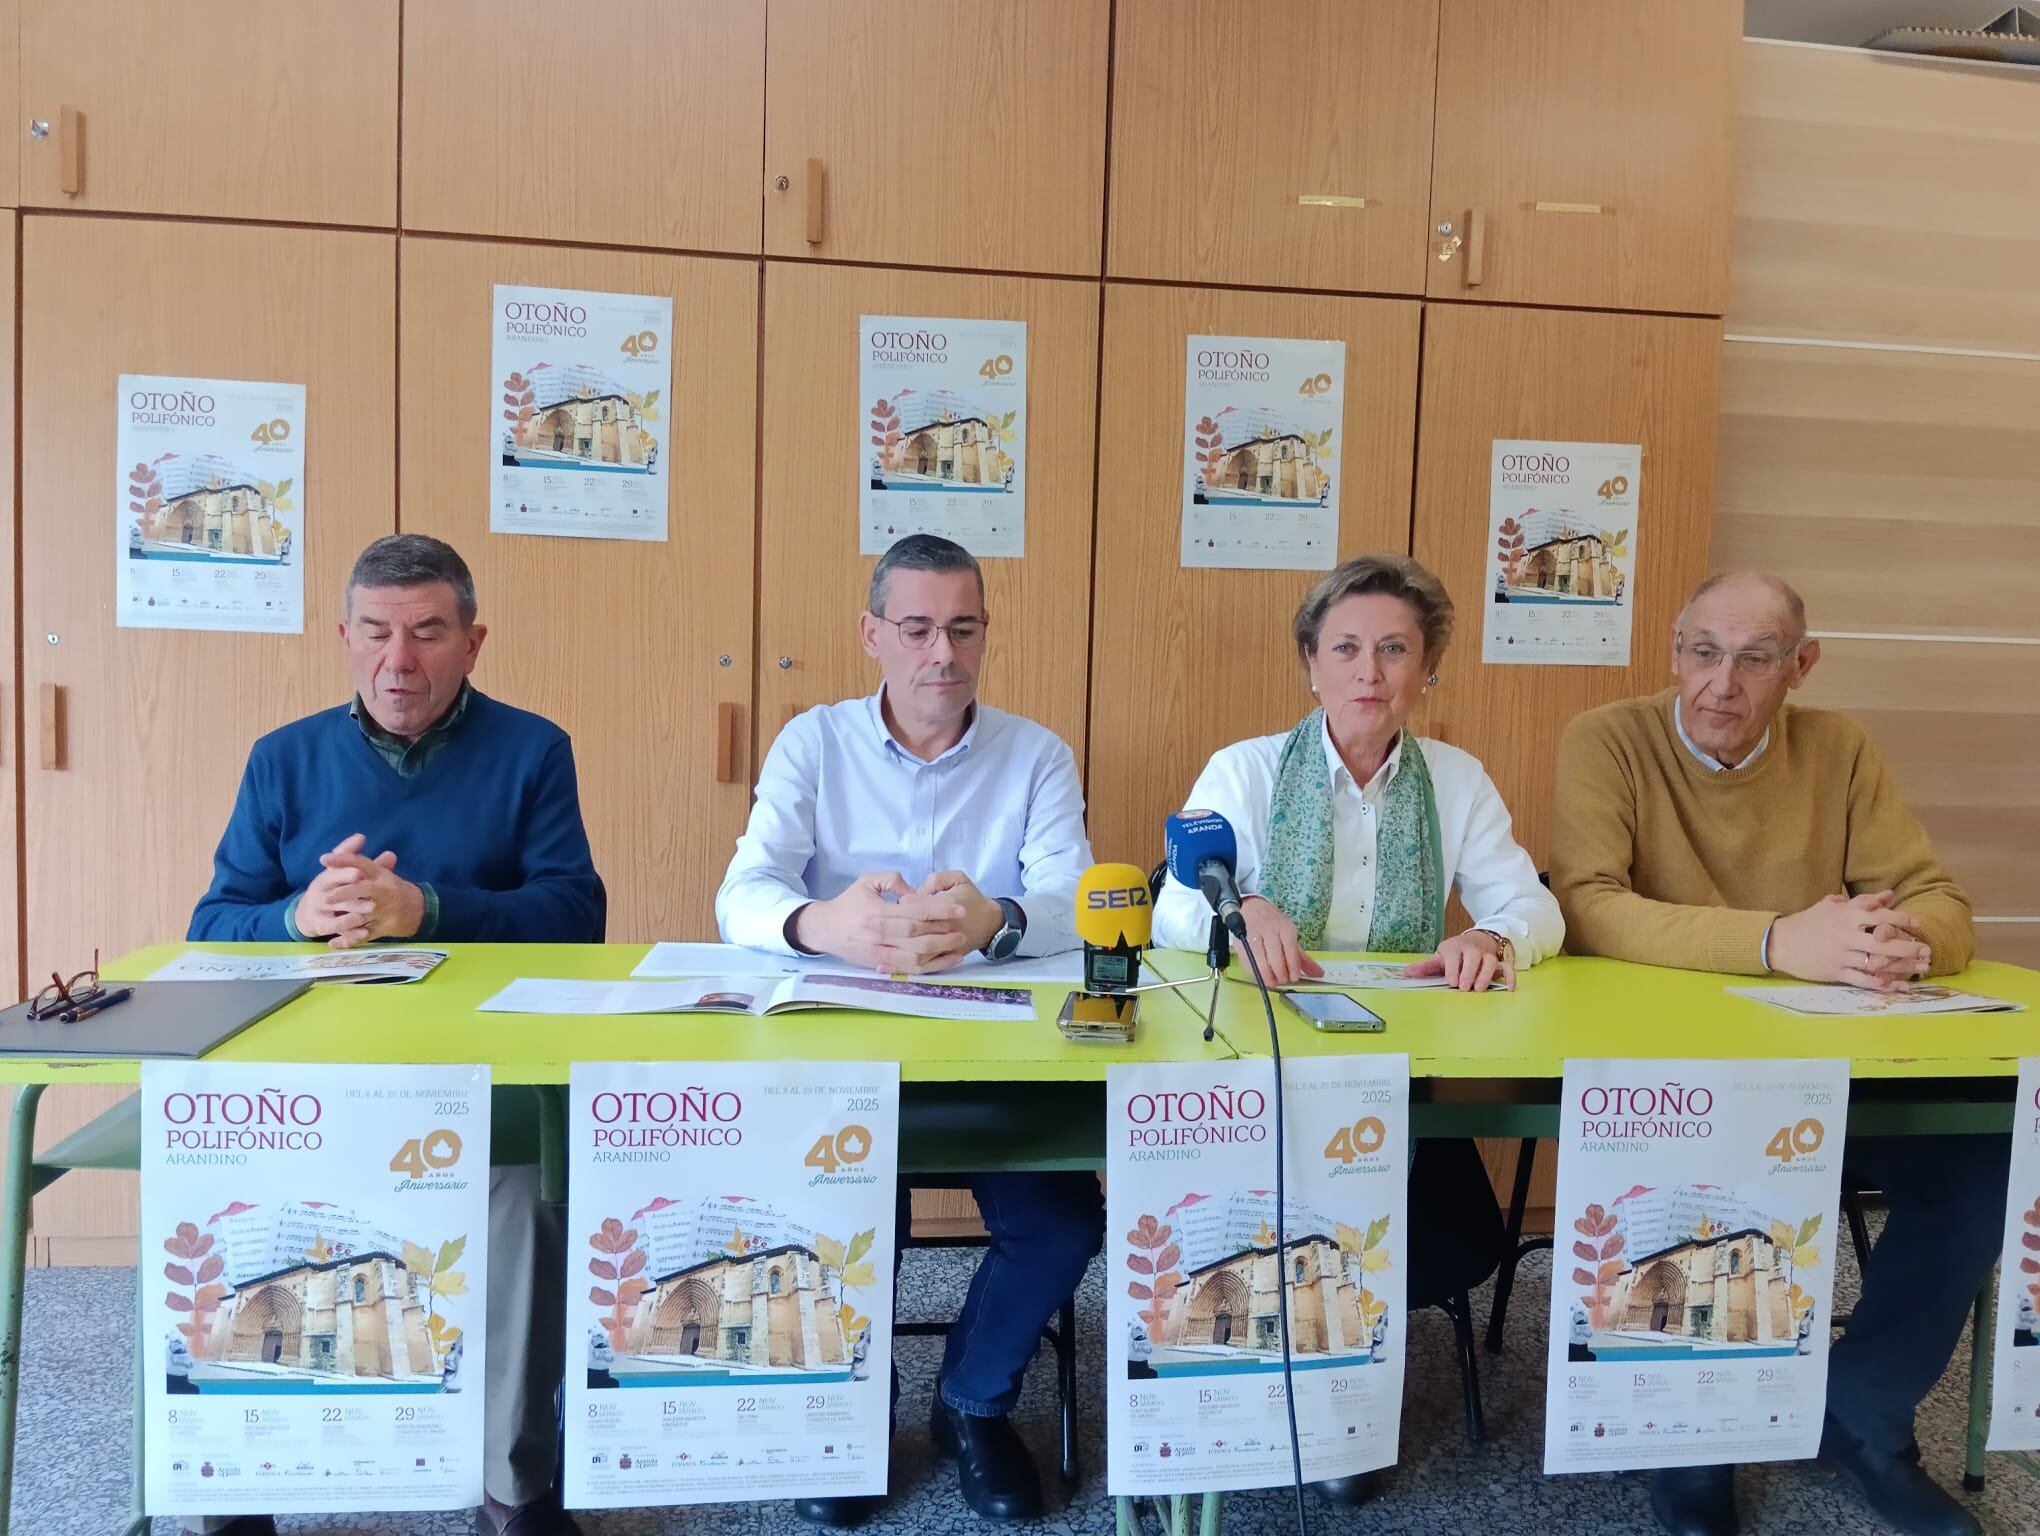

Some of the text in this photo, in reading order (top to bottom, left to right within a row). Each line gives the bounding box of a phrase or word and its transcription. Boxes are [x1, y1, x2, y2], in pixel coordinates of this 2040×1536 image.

[506, 302, 586, 324] OTOÑO
[506, 322, 587, 338] POLIFÓNICO
[621, 331, 658, 357] 40
[872, 330, 947, 350] OTOÑO
[872, 349, 948, 363] POLIFÓNICO
[1198, 350, 1270, 369] OTOÑO
[979, 354, 1014, 380] 40
[1198, 369, 1270, 382] POLIFÓNICO
[1298, 373, 1332, 398] 40
[131, 391, 215, 413] OTOÑO
[132, 411, 216, 427] POLIFÓNICO
[251, 418, 290, 446] 40
[1502, 453, 1570, 472] OTOÑO
[1502, 471, 1570, 485] POLIFÓNICO
[1597, 475, 1629, 500] 40
[1187, 824, 1223, 834] ARANDA
[1087, 887, 1149, 910] SER
[415, 1088, 470, 1099] NOVIEMBRE
[829, 1086, 879, 1095] NOVIEMBRE
[1362, 1091, 1392, 1104] 2025
[592, 1086, 742, 1124] OTOÑO
[847, 1098, 879, 1111] 2025
[1127, 1084, 1265, 1124] OTOÑO
[1580, 1082, 1713, 1117] OTOÑO
[1804, 1093, 1832, 1105] 2025
[164, 1088, 322, 1126] OTOÑO
[434, 1102, 470, 1116] 2025
[1128, 1122, 1266, 1147] POLIFÓNICO
[1581, 1117, 1712, 1138] POLIFÓNICO
[166, 1127, 322, 1151] POLIFÓNICO
[592, 1123, 742, 1147] POLIFÓNICO
[1325, 1116, 1386, 1164] 40
[1765, 1118, 1824, 1163] 40
[390, 1129, 463, 1179] 40
[804, 1125, 873, 1173] 40
[1580, 1142, 1649, 1153] ARANDINO
[166, 1153, 247, 1166] ARANDINO
[592, 1151, 671, 1163] ARANDINO
[1128, 1149, 1201, 1162] ARANDINO
[1328, 1164, 1391, 1178] Aniversario
[394, 1179, 469, 1193] Aniversario
[808, 1174, 877, 1187] Aniversario
[1568, 1376, 1577, 1389] 8
[1633, 1374, 1646, 1387] 15
[1697, 1371, 1714, 1384] 22
[1757, 1369, 1774, 1382] 29
[1267, 1384, 1286, 1399] 22
[1331, 1379, 1348, 1393] 29
[806, 1395, 825, 1409] 29
[1129, 1394, 1138, 1408] 8
[1199, 1389, 1212, 1403] 15
[588, 1404, 598, 1418] 8
[663, 1400, 677, 1415] 15
[737, 1398, 756, 1412] 22
[168, 1409, 178, 1424] 8
[245, 1409, 259, 1423] 15
[322, 1407, 342, 1422] 22
[395, 1407, 415, 1421] 29
